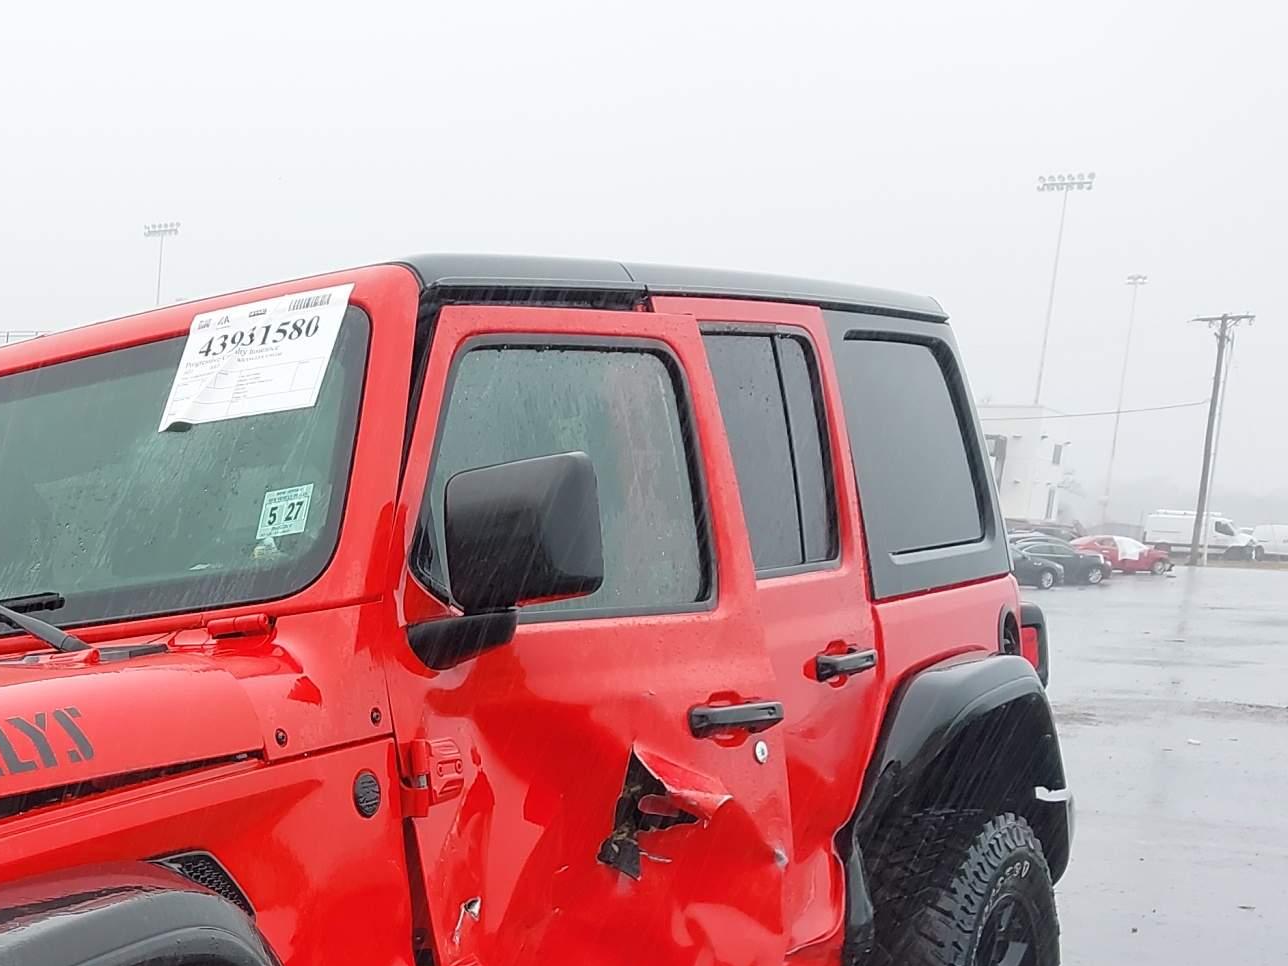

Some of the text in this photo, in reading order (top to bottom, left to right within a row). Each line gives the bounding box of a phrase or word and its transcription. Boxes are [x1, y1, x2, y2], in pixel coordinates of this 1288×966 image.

[199, 315, 321, 358] 43931580
[267, 500, 305, 526] 5 27
